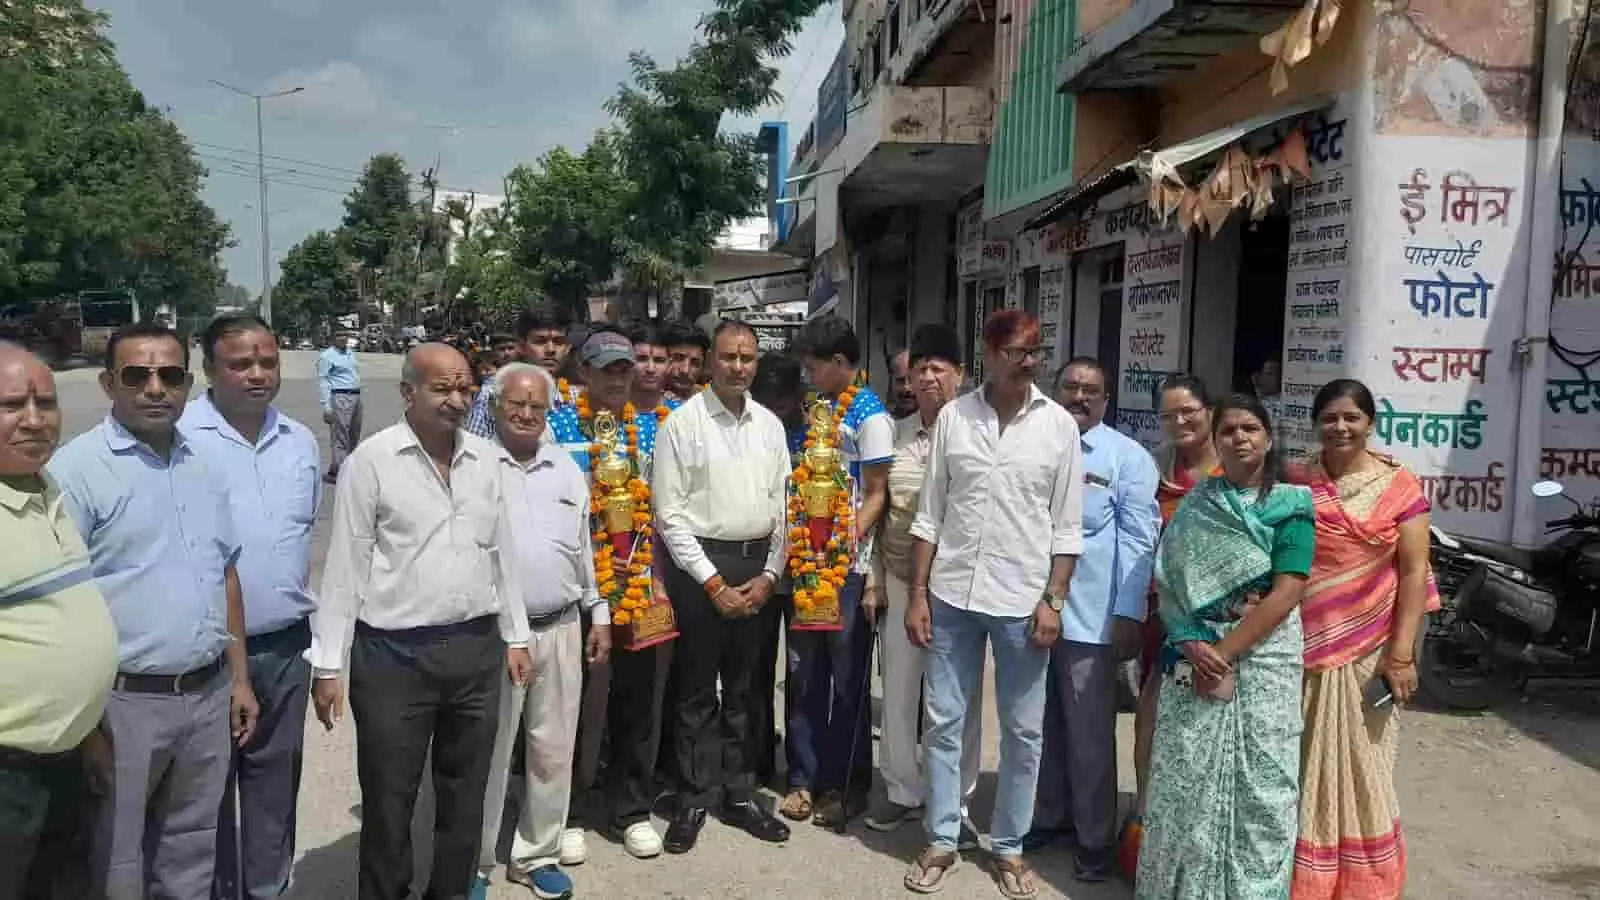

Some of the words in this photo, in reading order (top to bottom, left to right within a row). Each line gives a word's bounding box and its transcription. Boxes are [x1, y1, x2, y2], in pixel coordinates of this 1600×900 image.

[1398, 167, 1431, 235] ई
[1440, 170, 1517, 227] मित्र
[1558, 177, 1600, 227] फो
[1404, 240, 1483, 268] पासपोर्ट
[1403, 269, 1495, 319] फोटो
[1392, 346, 1493, 384] स्टाम्प
